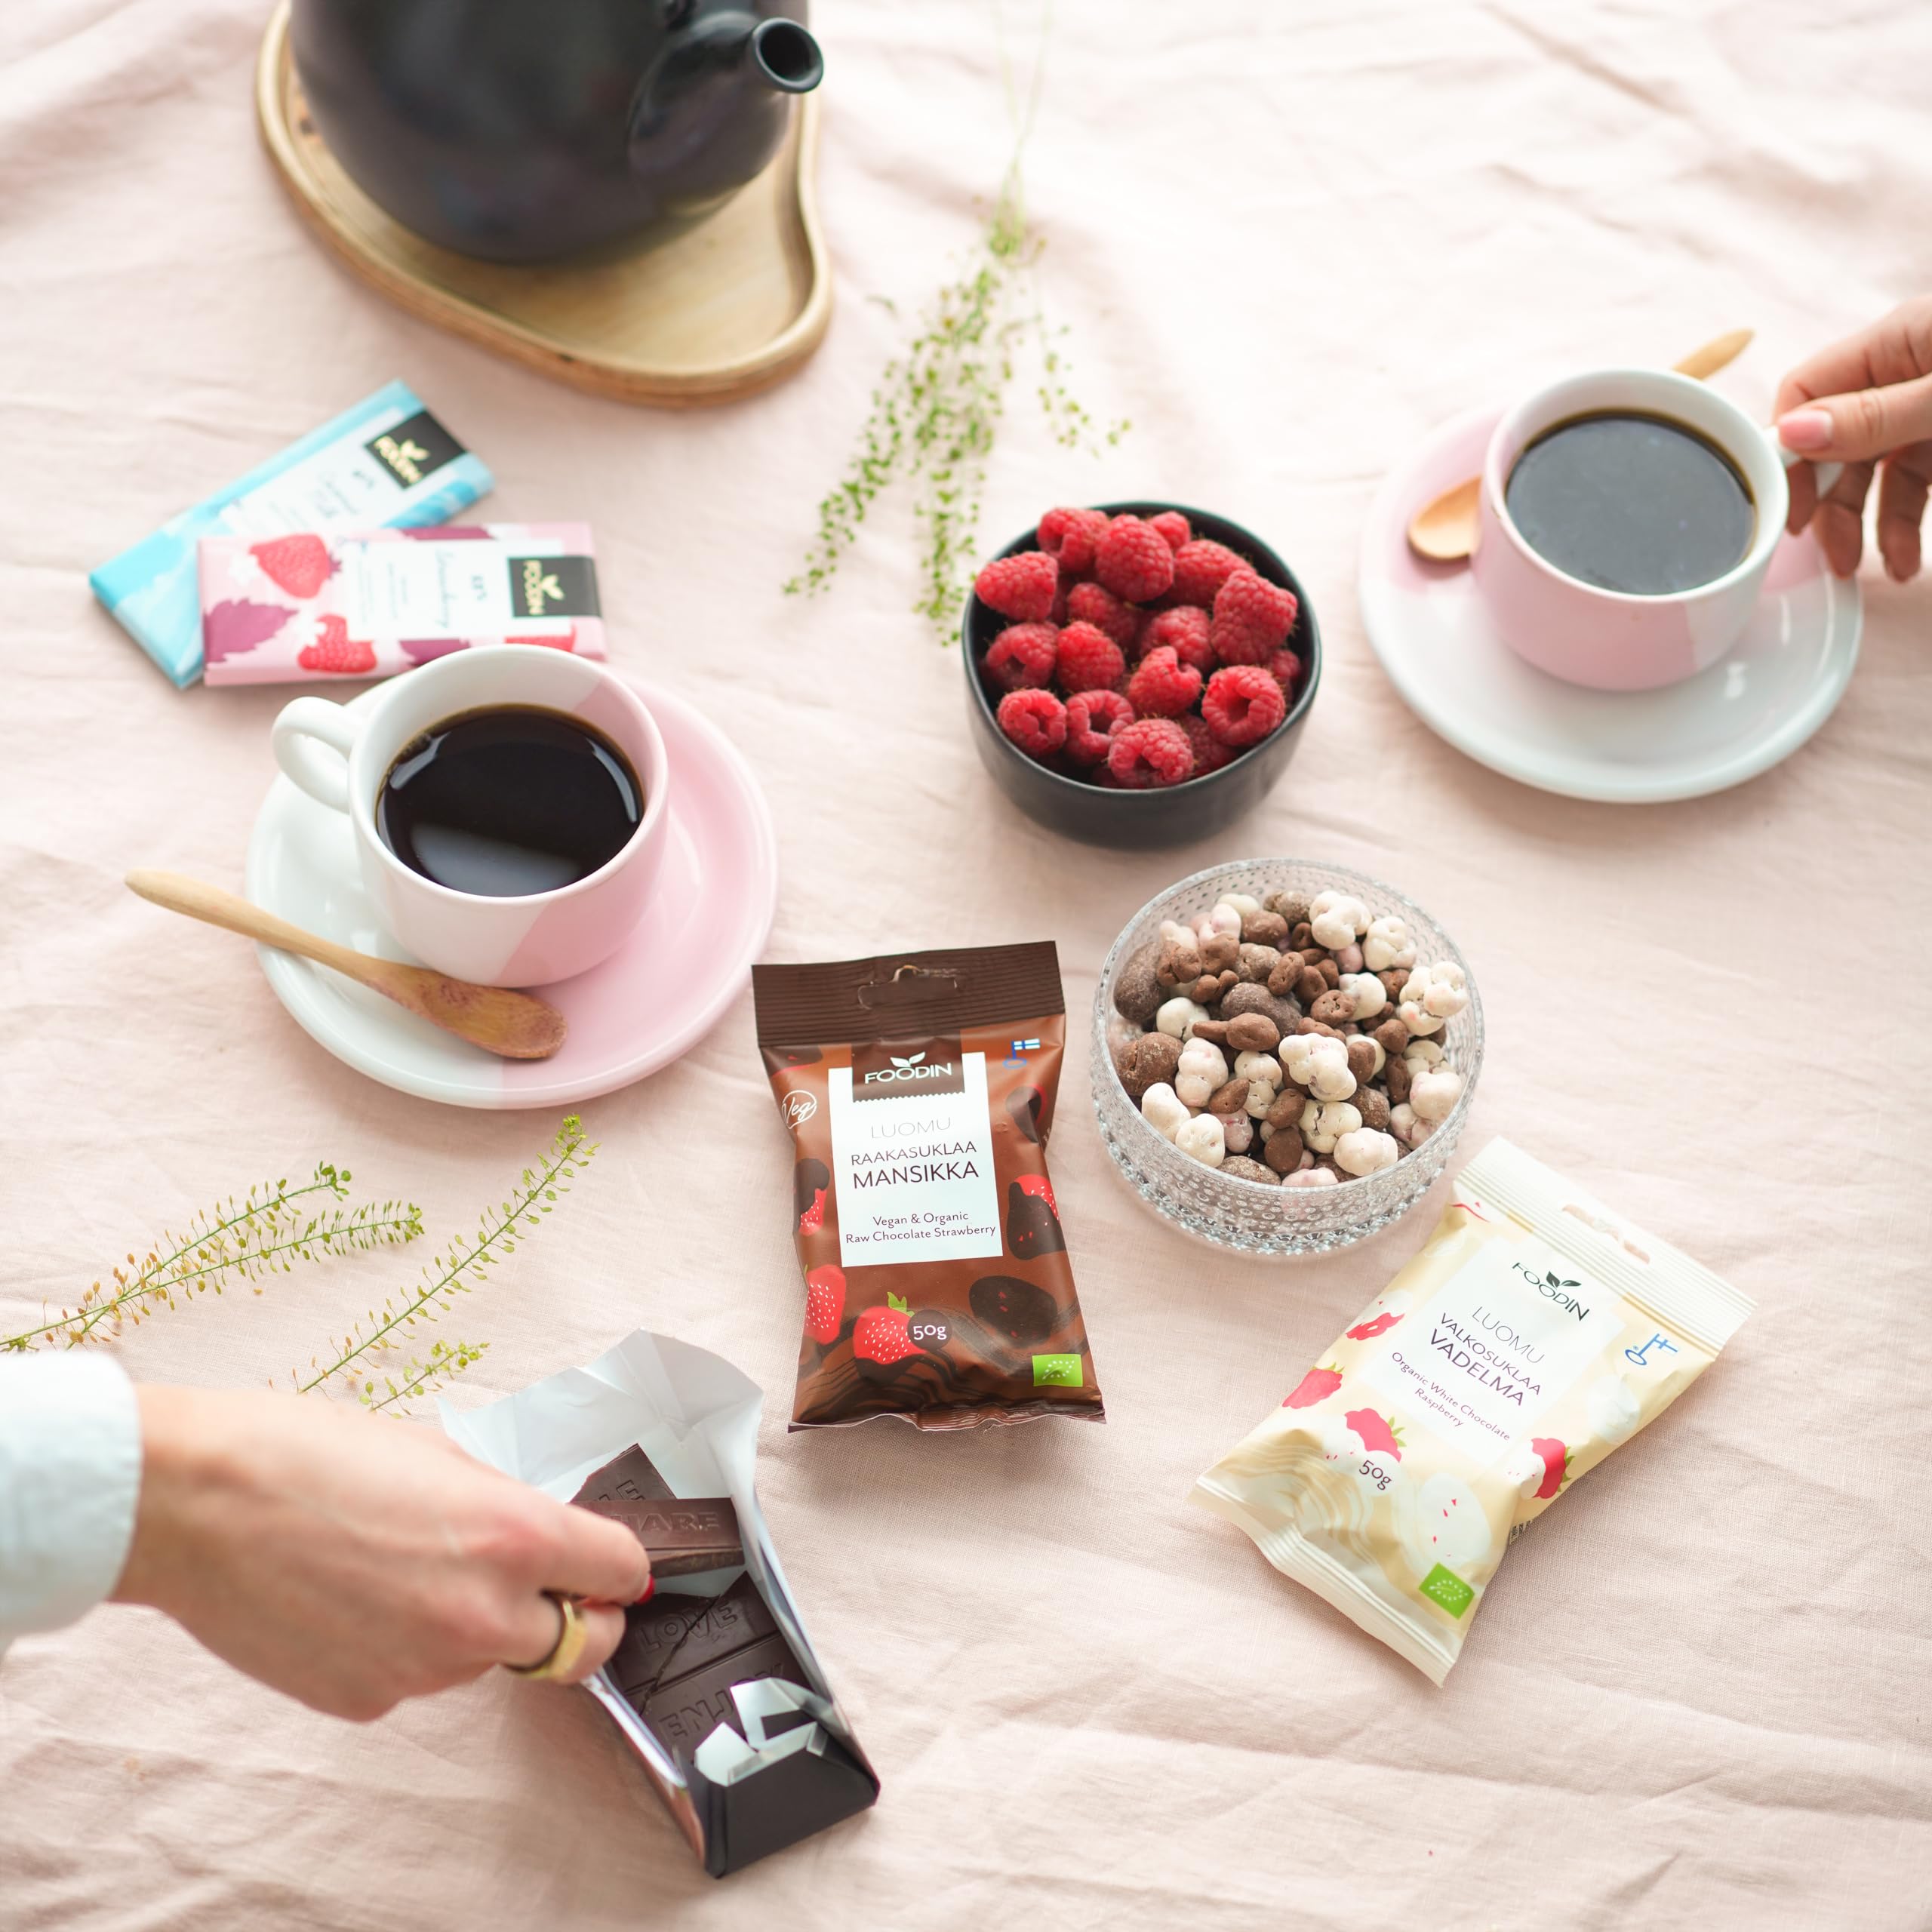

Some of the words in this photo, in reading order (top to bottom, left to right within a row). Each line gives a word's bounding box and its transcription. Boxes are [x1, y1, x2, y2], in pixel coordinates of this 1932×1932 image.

[864, 1063, 952, 1084] FOODIN
[870, 1116, 952, 1139] LUOMU
[851, 1140, 977, 1166] RAAKASUKLAA
[853, 1161, 980, 1189] MANSIKKA
[845, 1233, 870, 1244] Raw
[872, 1228, 932, 1241] Chocolate
[934, 1225, 996, 1238] Strawberry
[872, 1215, 908, 1229] Vegan
[910, 1213, 921, 1224] &
[923, 1211, 970, 1226] Organic
[1512, 1262, 1590, 1321] FOODIN
[912, 1324, 947, 1340] 50g
[1472, 1306, 1546, 1364] LUOMU
[1430, 1327, 1524, 1406] VADELMA
[1441, 1312, 1541, 1395] VALKOSUKLAA
[1392, 1352, 1429, 1386] Organic
[1430, 1382, 1459, 1407] White
[1460, 1404, 1510, 1441] Chocolate
[1414, 1387, 1465, 1427] Raspberry
[1358, 1459, 1392, 1491] 50g
[609, 1511, 719, 1532] HARE
[636, 1598, 738, 1654] LOVE
